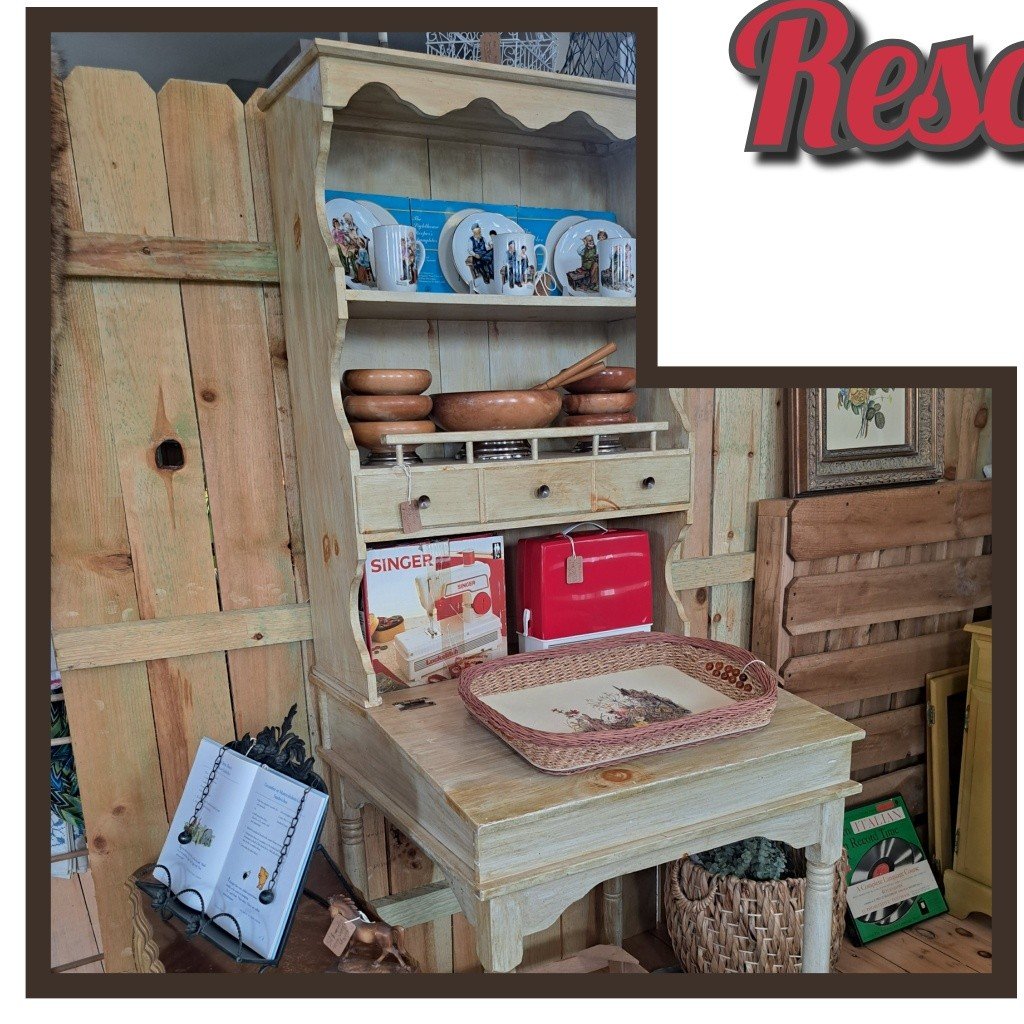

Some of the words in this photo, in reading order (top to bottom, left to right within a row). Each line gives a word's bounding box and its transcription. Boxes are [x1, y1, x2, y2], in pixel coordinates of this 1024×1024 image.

[370, 553, 433, 573] SINGER
[457, 580, 476, 590] SINGER
[853, 808, 903, 832] ITALIAN
[850, 834, 878, 848] Record
[880, 828, 900, 839] Time
